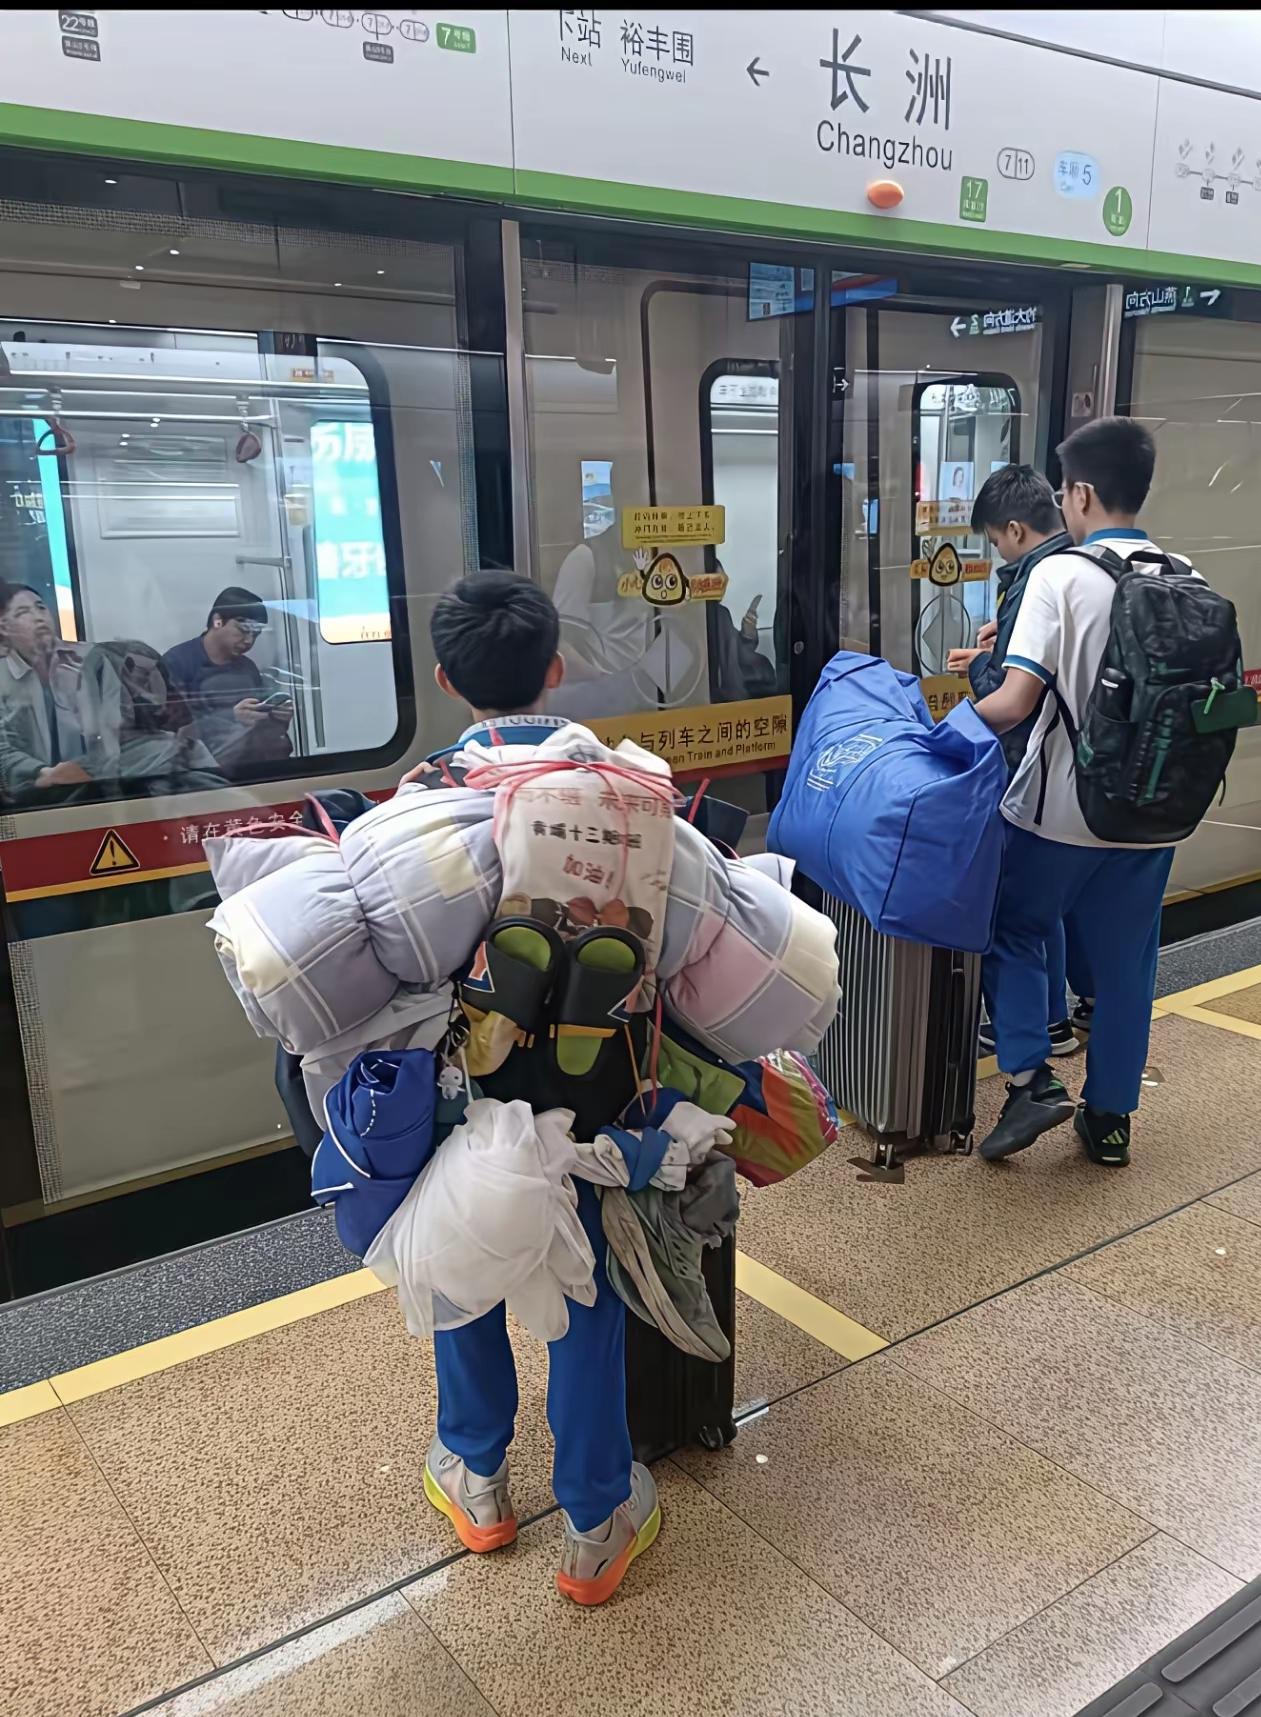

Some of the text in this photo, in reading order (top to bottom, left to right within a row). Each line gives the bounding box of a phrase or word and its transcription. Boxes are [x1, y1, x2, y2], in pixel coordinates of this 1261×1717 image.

[620, 19, 693, 66] 裕丰围
[561, 46, 686, 83] Next Yufengwei
[819, 27, 951, 131] 长洲
[817, 119, 952, 171] Changzhou
[967, 180, 982, 198] 17
[1115, 189, 1122, 213] 1
[600, 714, 788, 752] 与列车之间的空隙
[688, 750, 713, 762] Train
[715, 745, 734, 758] and
[736, 740, 776, 755] Platform
